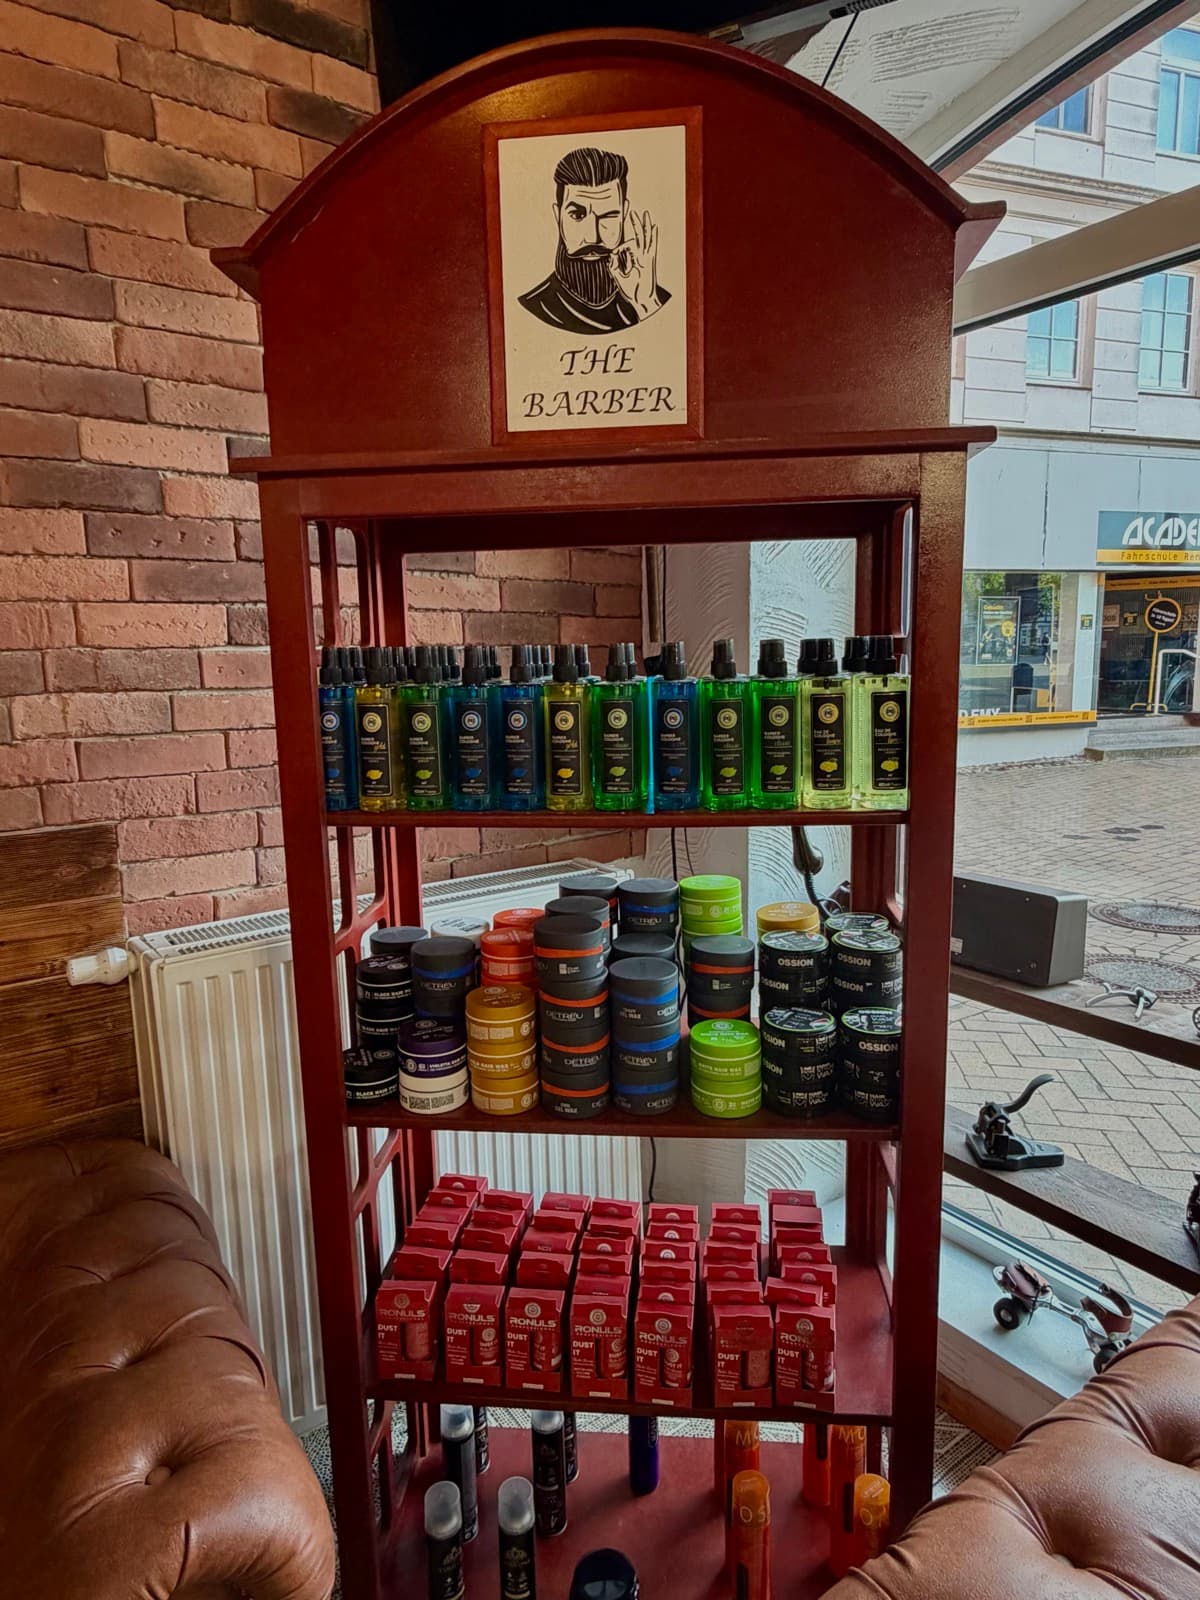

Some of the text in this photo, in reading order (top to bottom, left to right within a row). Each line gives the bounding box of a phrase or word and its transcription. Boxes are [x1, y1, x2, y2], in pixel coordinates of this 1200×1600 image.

[559, 344, 636, 376] THE
[523, 386, 676, 418] BARBER
[1122, 516, 1200, 546] ACADE
[1121, 552, 1178, 561] Fahrschule
[777, 958, 814, 968] OSSION
[837, 952, 872, 967] OSSION
[858, 1041, 898, 1053] OSSION
[379, 1308, 426, 1318] RONULS
[448, 1312, 495, 1323] RONULS
[509, 1316, 557, 1328] RONULS
[377, 1323, 398, 1332] DUST
[446, 1327, 467, 1336] DUST
[574, 1325, 622, 1334] RONULS
[378, 1331, 385, 1339] IT
[447, 1335, 455, 1343] IT
[507, 1332, 528, 1341] DUST
[638, 1331, 688, 1345] RONULS
[507, 1340, 515, 1348] IT
[572, 1340, 594, 1349] DUST
[572, 1348, 580, 1356] IT
[636, 1347, 658, 1356] DUST
[777, 1348, 800, 1358] DUST
[636, 1355, 644, 1363] IT
[717, 1352, 740, 1361] DUST
[777, 1356, 785, 1364] IT
[717, 1360, 725, 1369] IT
